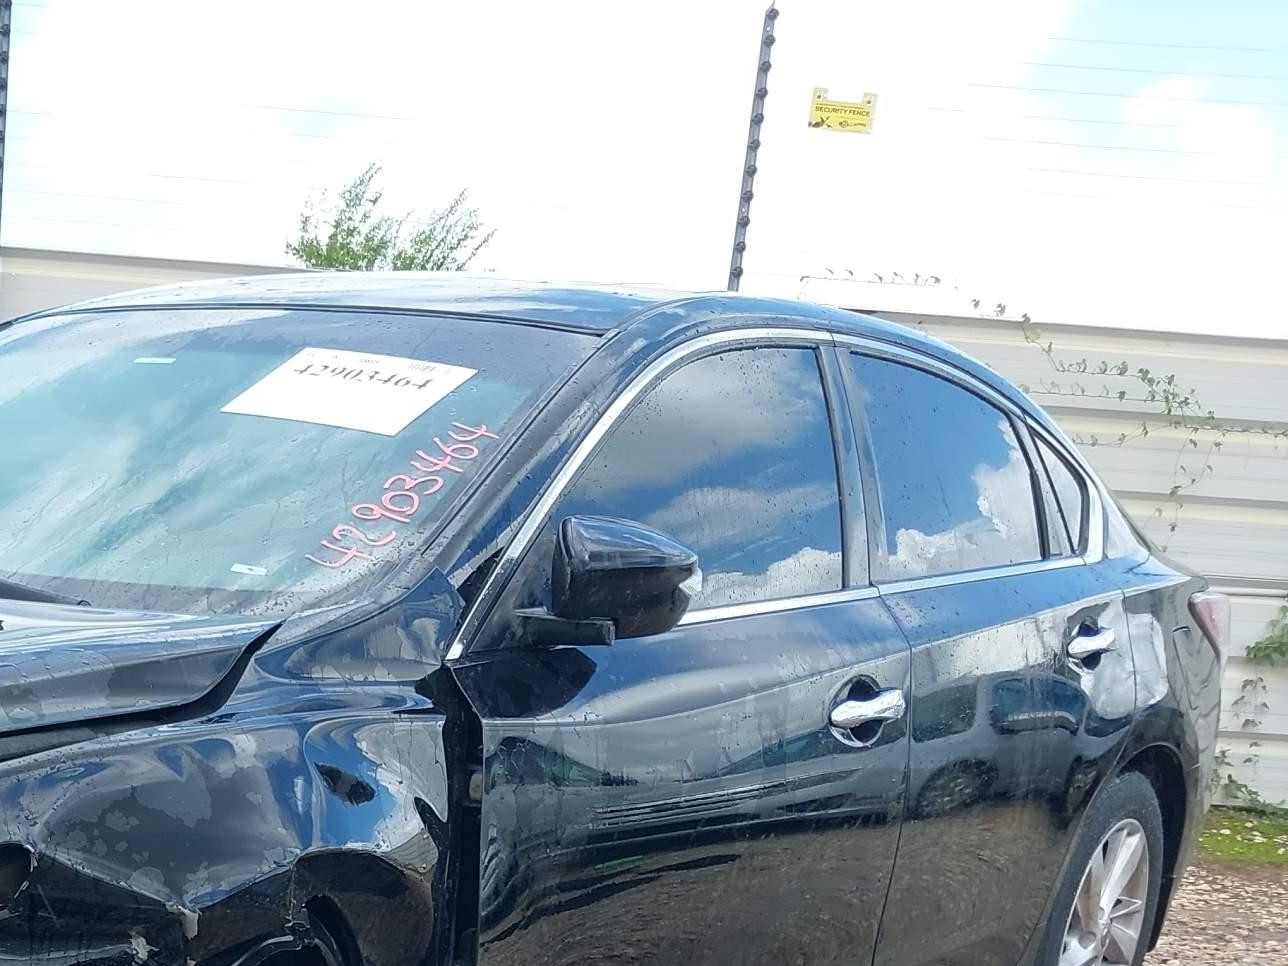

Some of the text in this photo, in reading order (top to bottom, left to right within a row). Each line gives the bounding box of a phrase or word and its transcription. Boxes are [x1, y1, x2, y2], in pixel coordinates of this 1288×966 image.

[815, 106, 848, 114] SECURITY
[848, 109, 871, 117] FENCE
[293, 363, 434, 389] 42903464
[305, 422, 500, 568] 42903464
